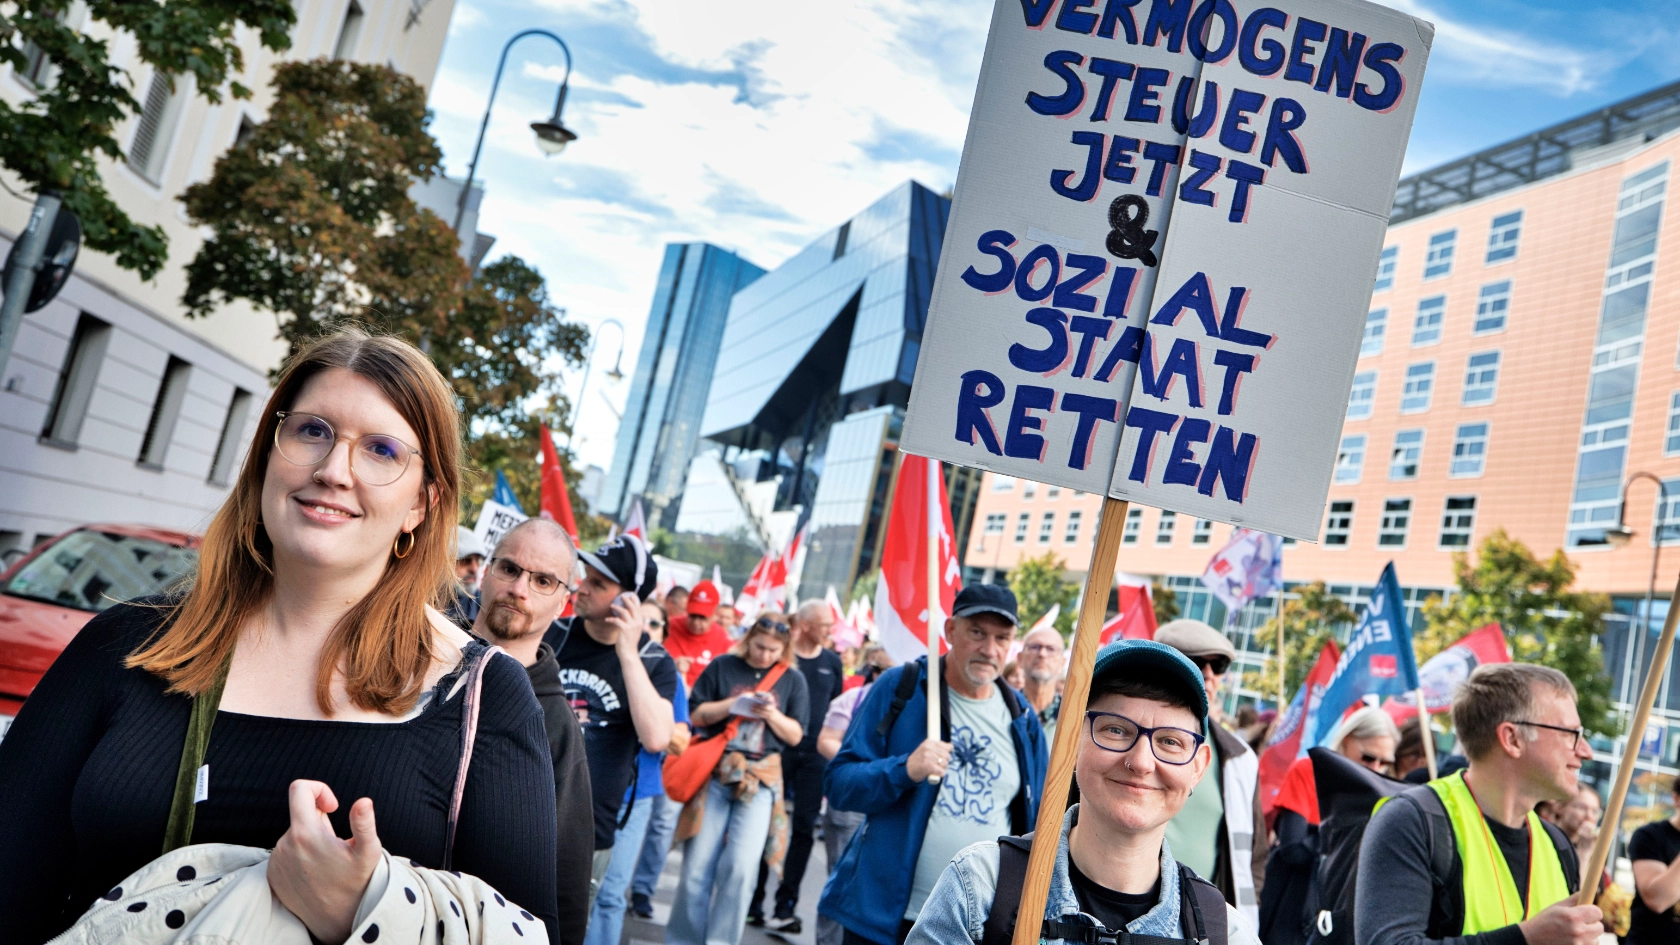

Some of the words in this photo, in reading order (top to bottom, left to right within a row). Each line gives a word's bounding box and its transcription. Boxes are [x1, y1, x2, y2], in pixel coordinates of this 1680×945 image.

[1025, 50, 1309, 174] STEUER
[1050, 130, 1264, 223] JETZT
[1105, 193, 1159, 267] &
[1008, 307, 1257, 416] STAAT
[955, 369, 1259, 504] RETTEN
